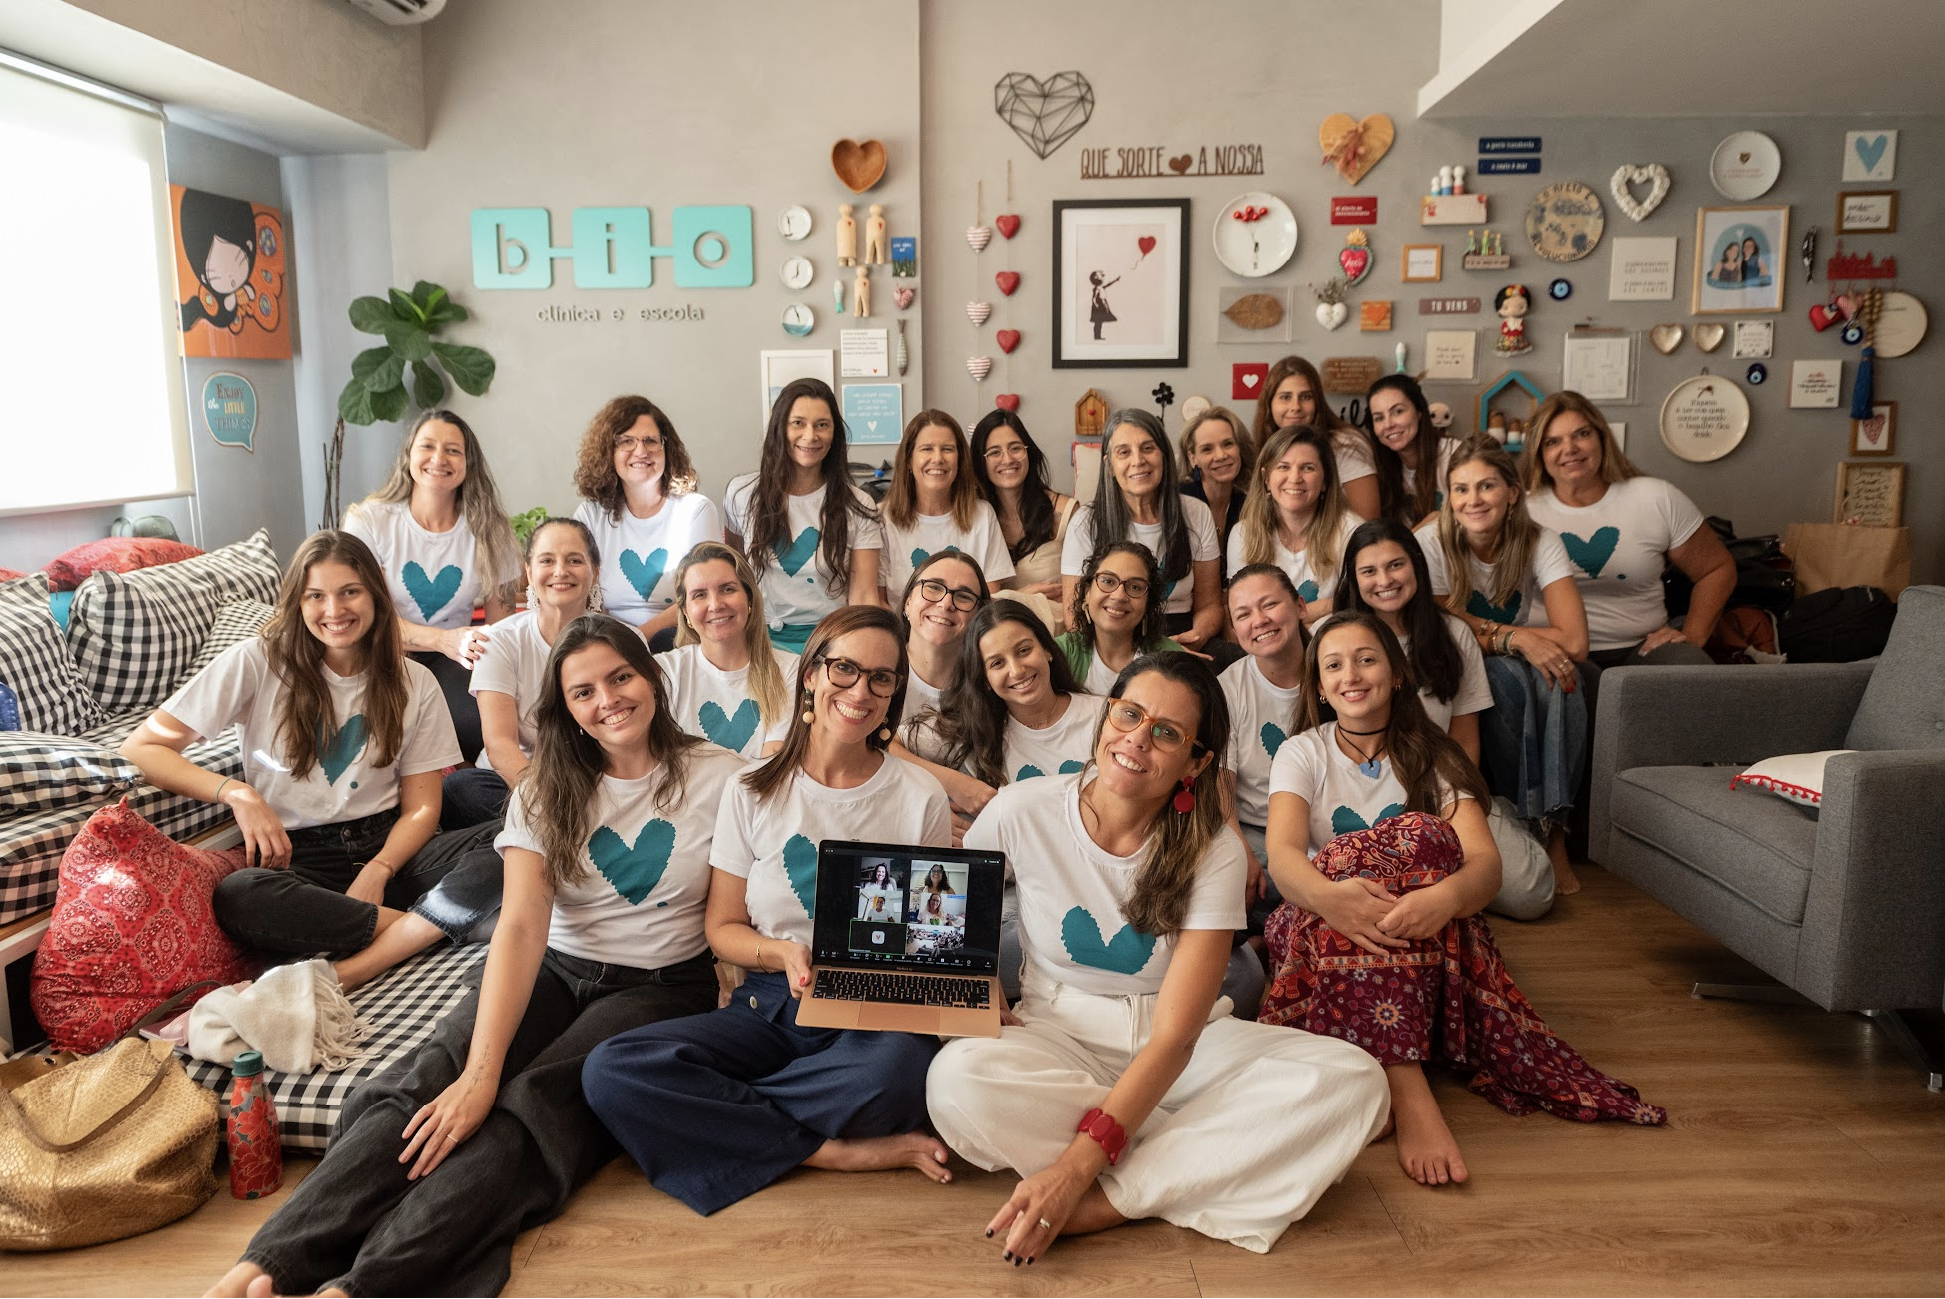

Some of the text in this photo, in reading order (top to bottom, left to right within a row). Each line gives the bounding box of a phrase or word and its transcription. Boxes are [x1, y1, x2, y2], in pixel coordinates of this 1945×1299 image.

[1081, 144, 1265, 179] QUE SORTE A NOSSA
[495, 222, 731, 275] bio
[536, 303, 706, 323] clínica e escola
[1431, 300, 1443, 312] TU
[224, 401, 246, 415] LITTLE
